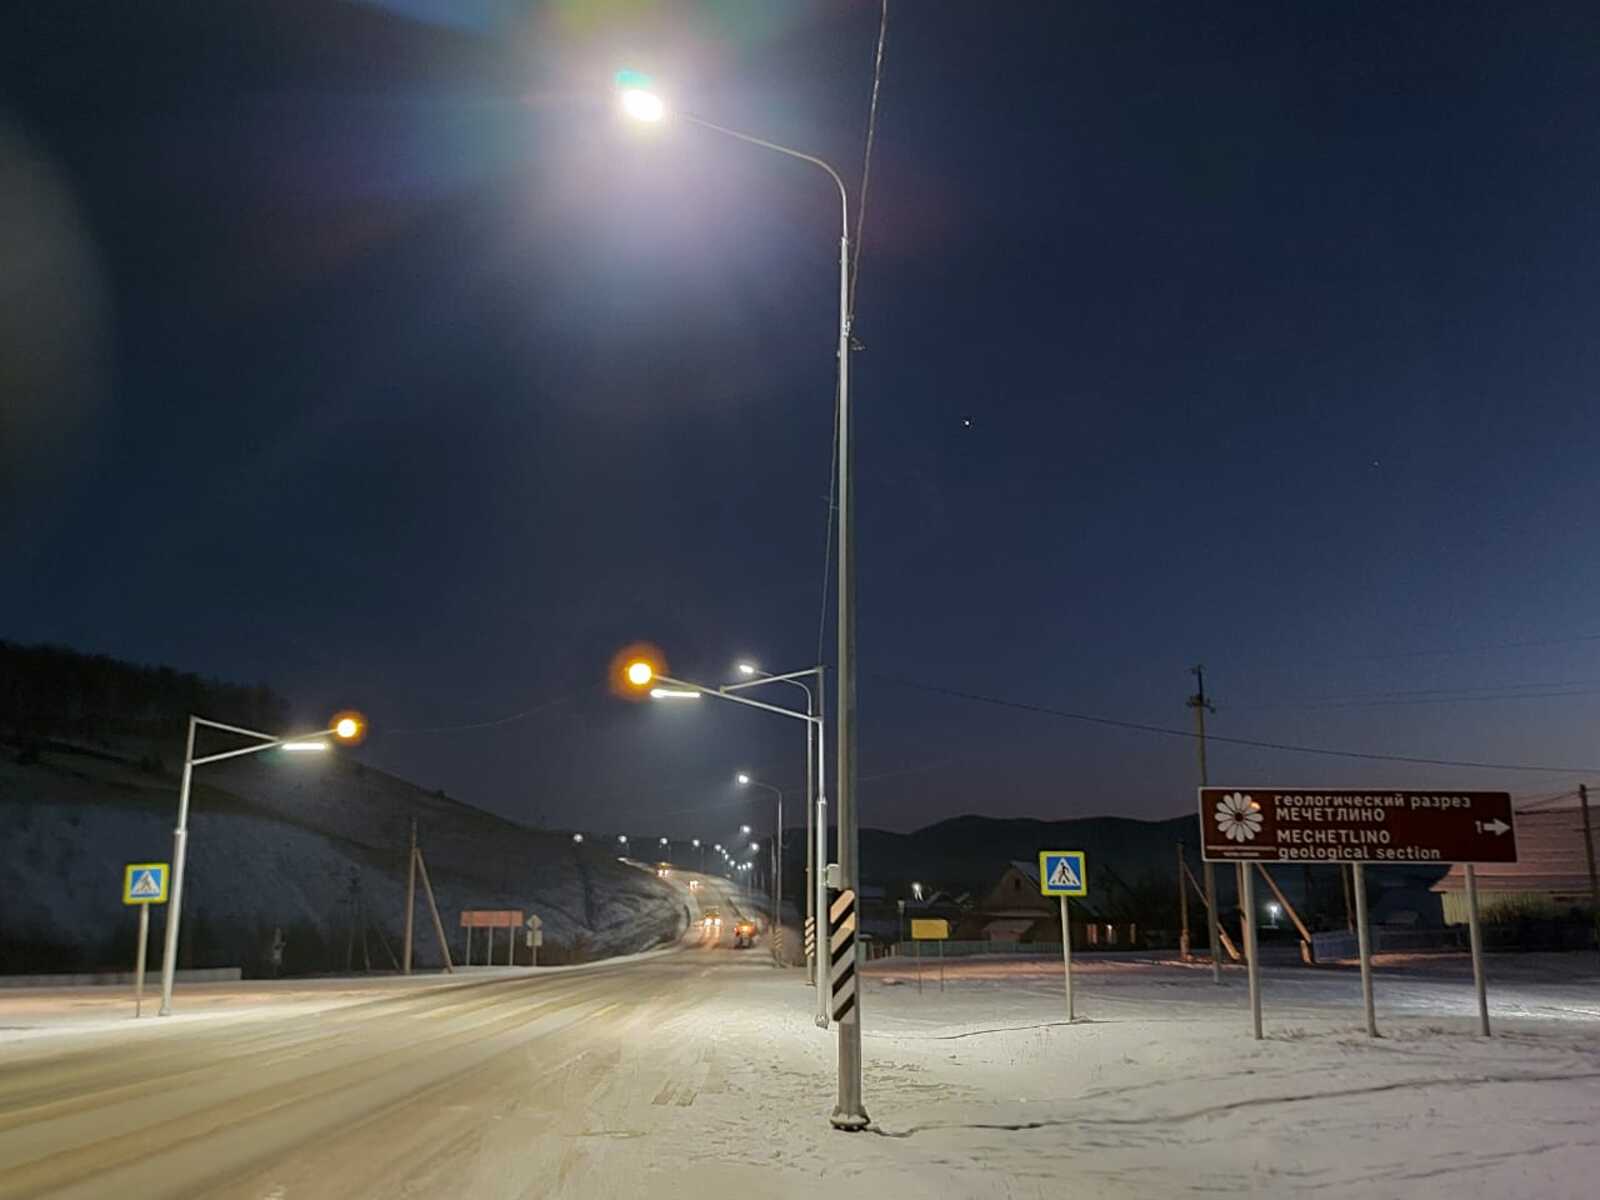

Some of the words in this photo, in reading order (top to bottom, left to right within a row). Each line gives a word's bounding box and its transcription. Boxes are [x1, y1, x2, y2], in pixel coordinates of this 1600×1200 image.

[1273, 793, 1405, 806] геологический
[1410, 796, 1471, 810] разрез
[1275, 807, 1385, 822] МЕЧЕТЛИНО
[1277, 829, 1391, 844] MECHETLINO
[1278, 845, 1370, 861] geological
[1376, 846, 1441, 860] section
